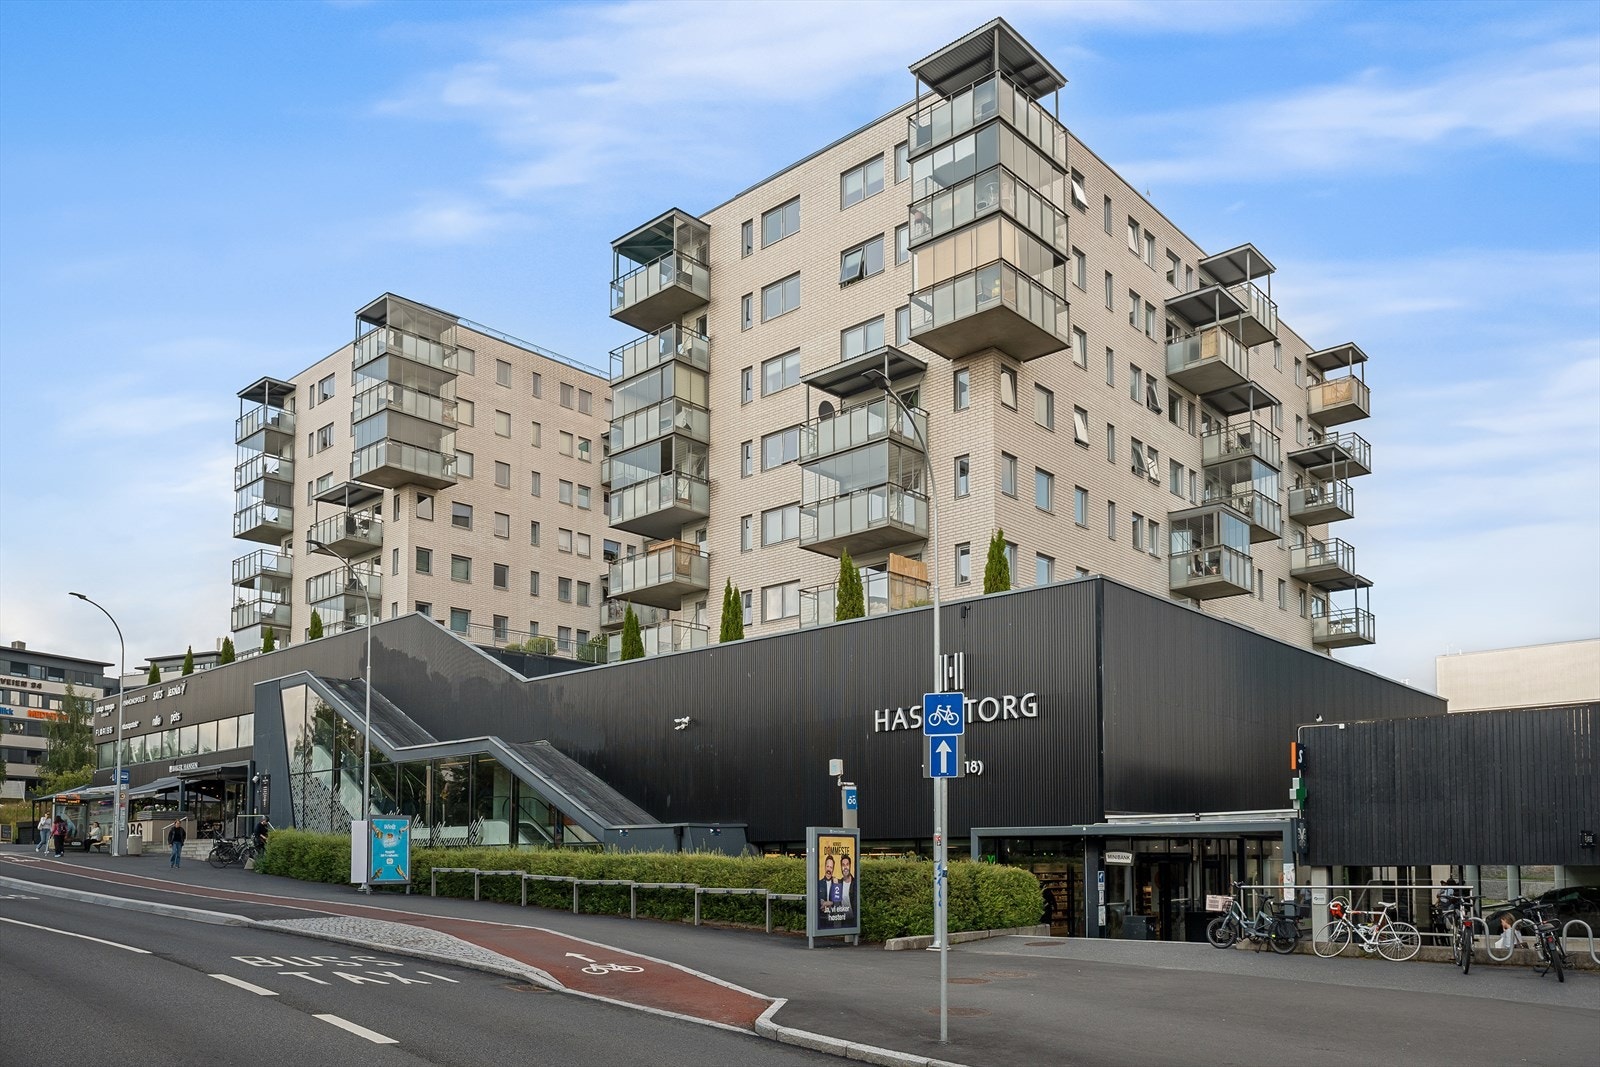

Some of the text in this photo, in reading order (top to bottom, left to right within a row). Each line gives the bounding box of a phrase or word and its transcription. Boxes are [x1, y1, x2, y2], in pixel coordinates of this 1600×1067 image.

[875, 692, 1038, 733] HAS TORG
[963, 760, 985, 775] 18)
[231, 956, 404, 967] BUSS
[277, 971, 460, 985] TAXI
